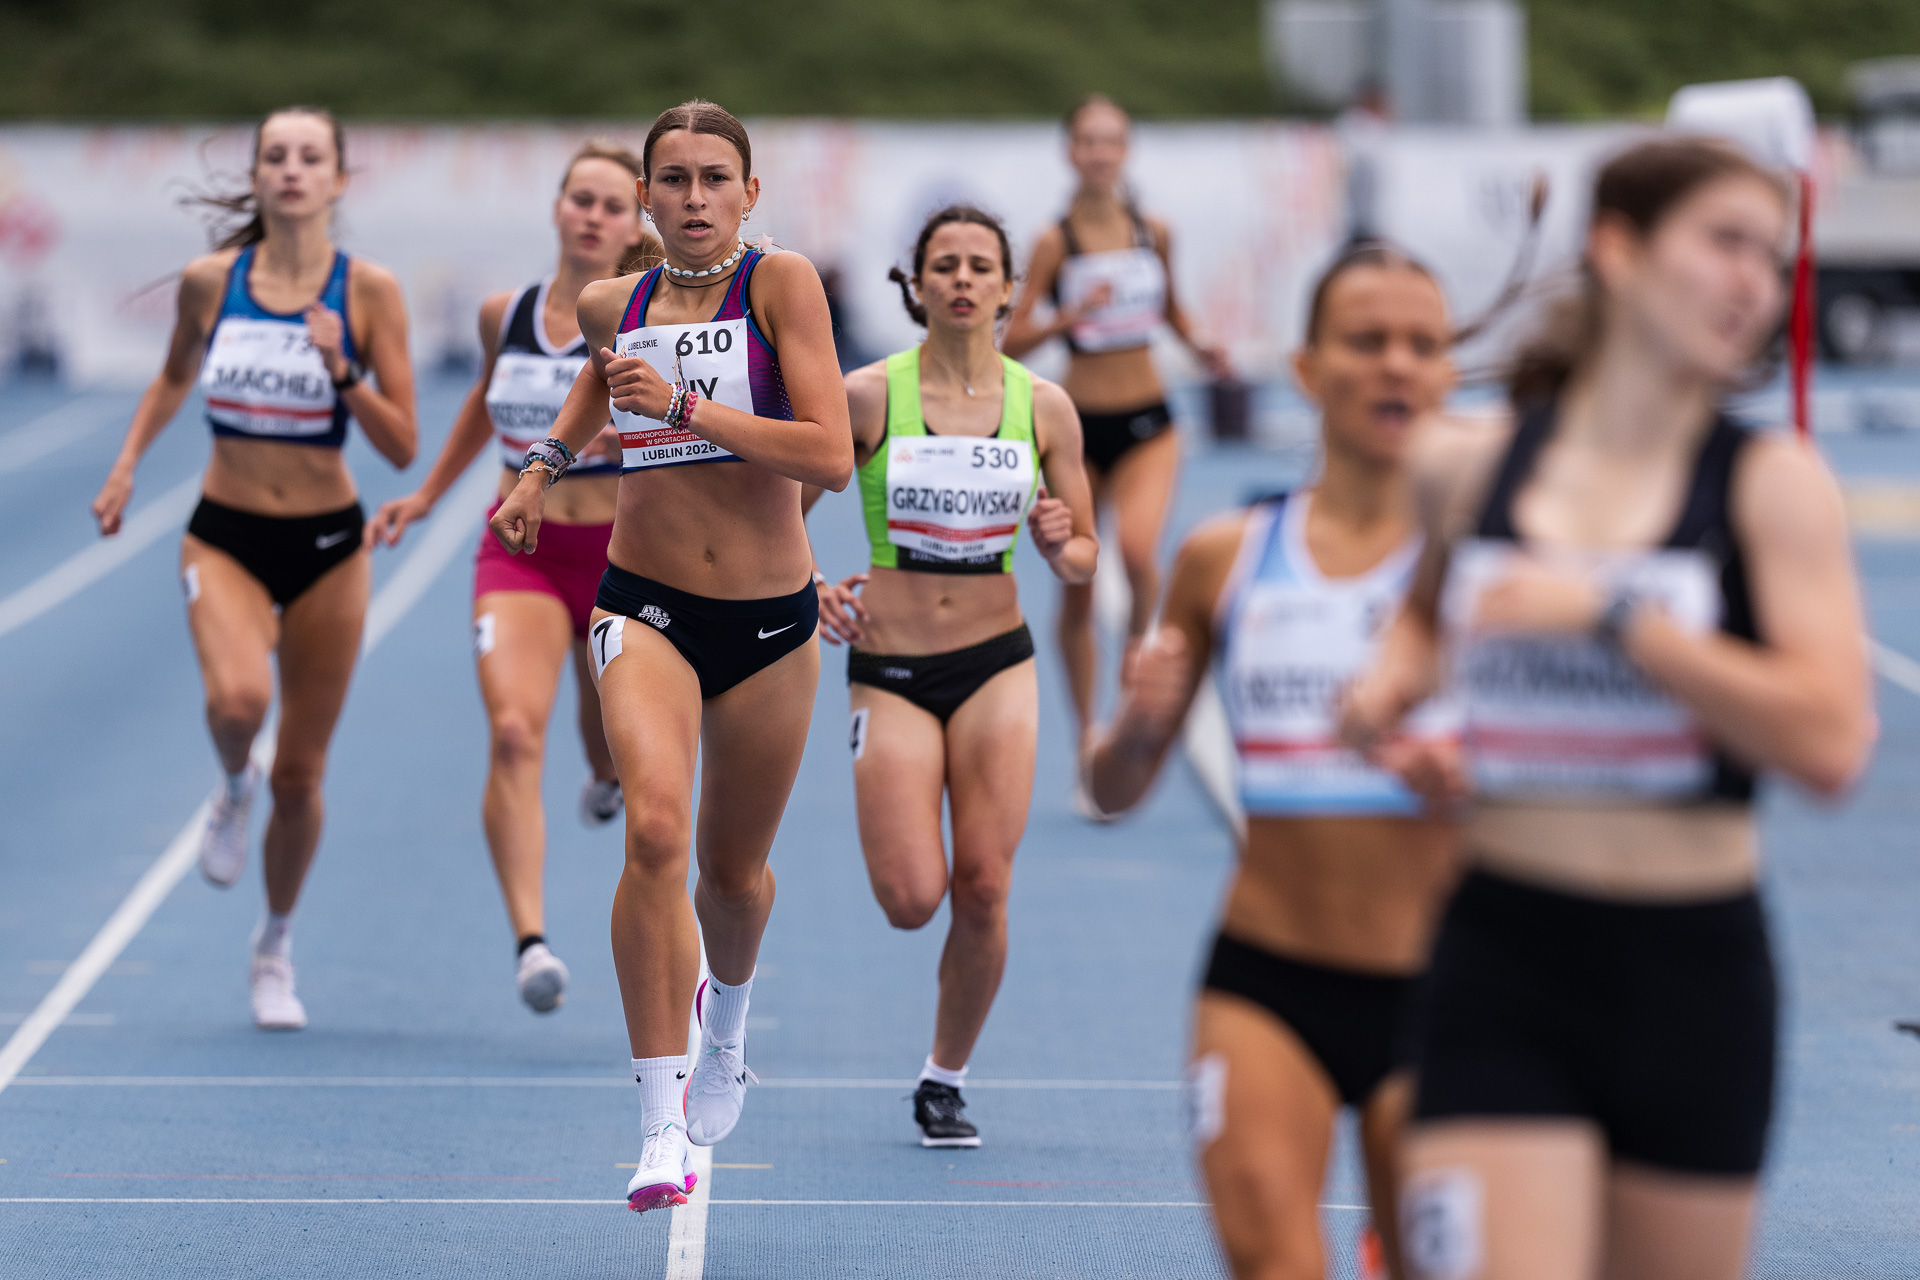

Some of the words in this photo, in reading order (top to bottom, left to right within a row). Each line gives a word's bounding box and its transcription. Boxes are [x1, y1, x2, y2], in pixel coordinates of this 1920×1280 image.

[627, 339, 658, 351] LUBELSKIE
[675, 328, 733, 357] 610
[642, 446, 683, 462] LUBLIN
[685, 442, 718, 456] 2026
[645, 438, 653, 446] W
[653, 433, 686, 445] SPORTACH
[970, 445, 1019, 470] 530
[892, 487, 1022, 516] GRZYBOWSKA
[593, 618, 615, 667] 7
